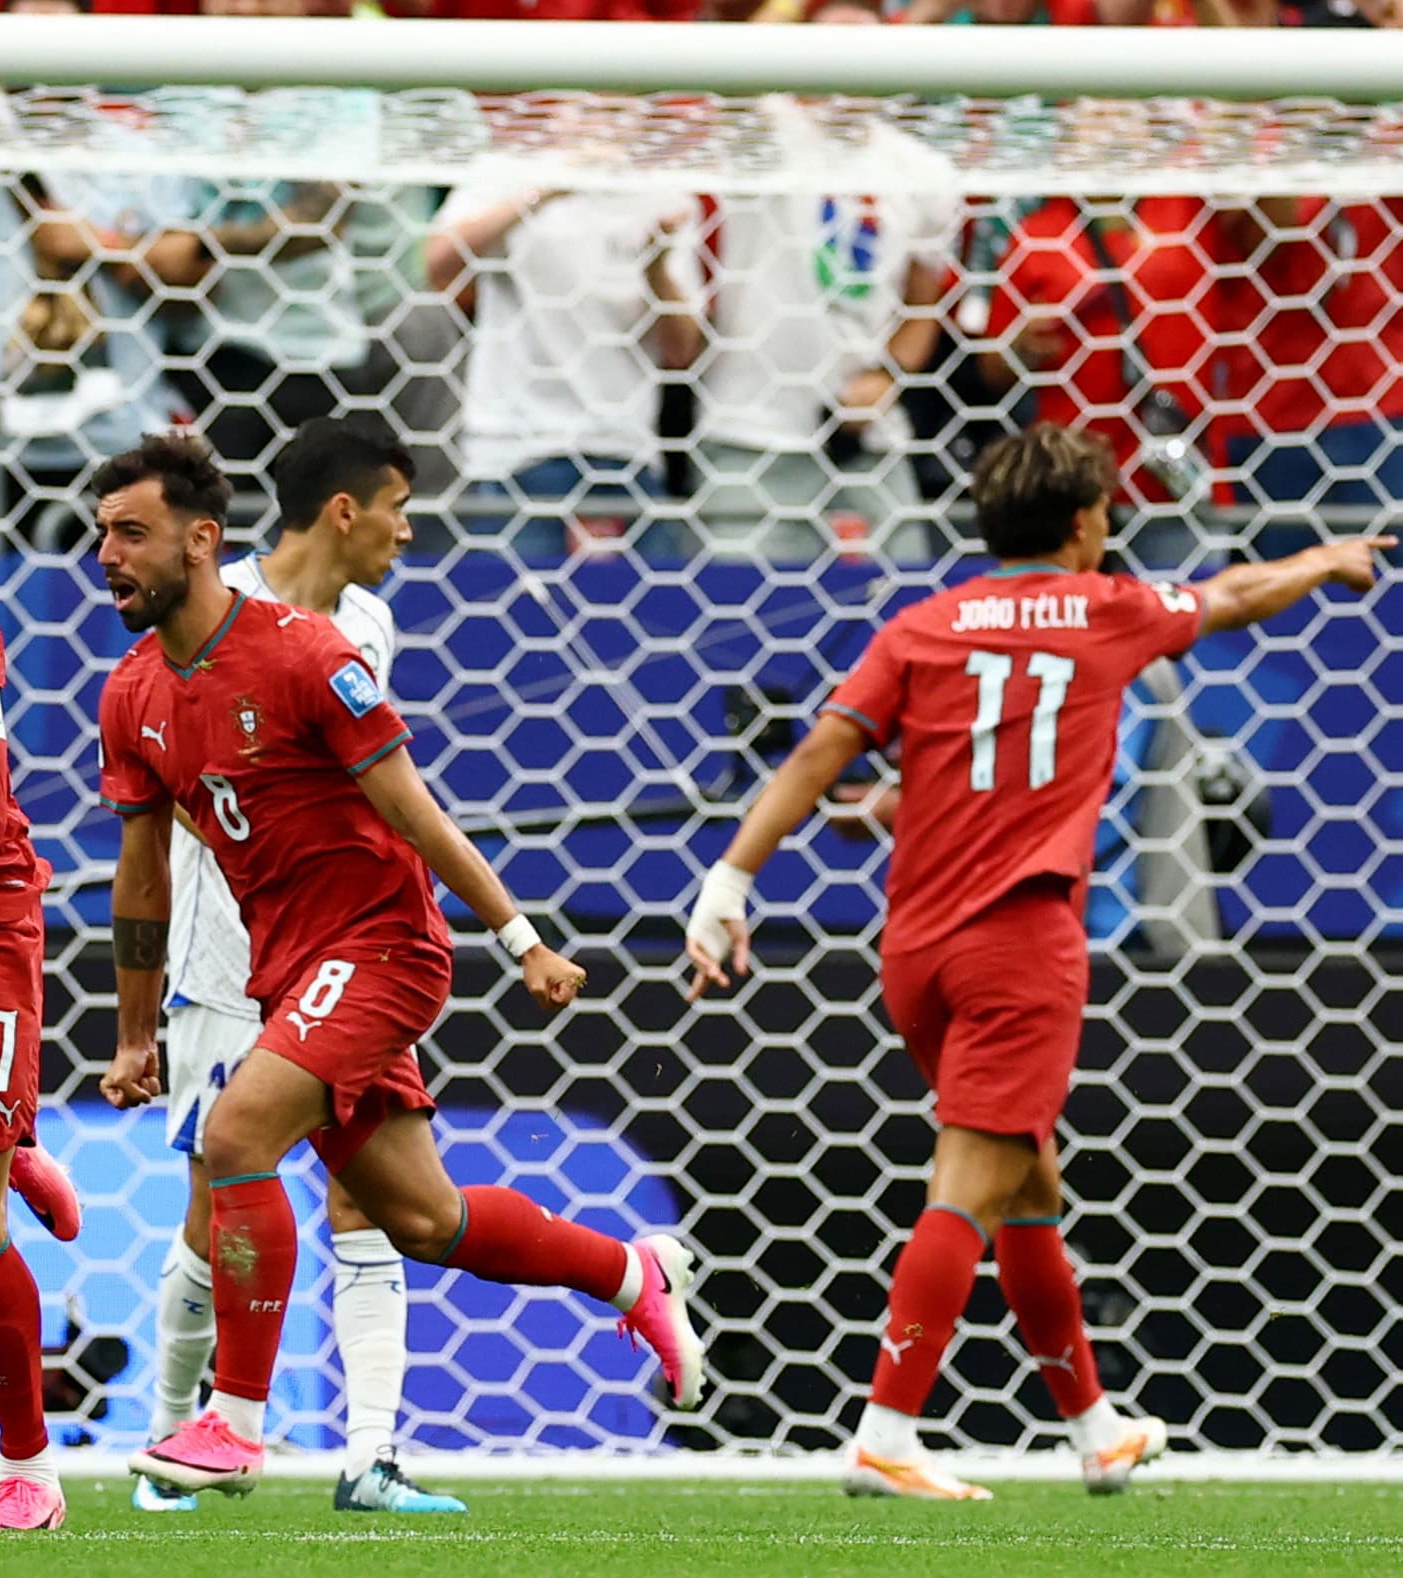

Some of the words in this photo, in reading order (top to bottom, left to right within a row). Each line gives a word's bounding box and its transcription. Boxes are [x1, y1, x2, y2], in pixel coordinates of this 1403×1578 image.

[1020, 593, 1088, 630] FÉLIX
[965, 650, 1075, 792] 11
[198, 773, 250, 841] 8
[299, 959, 357, 1019] 8
